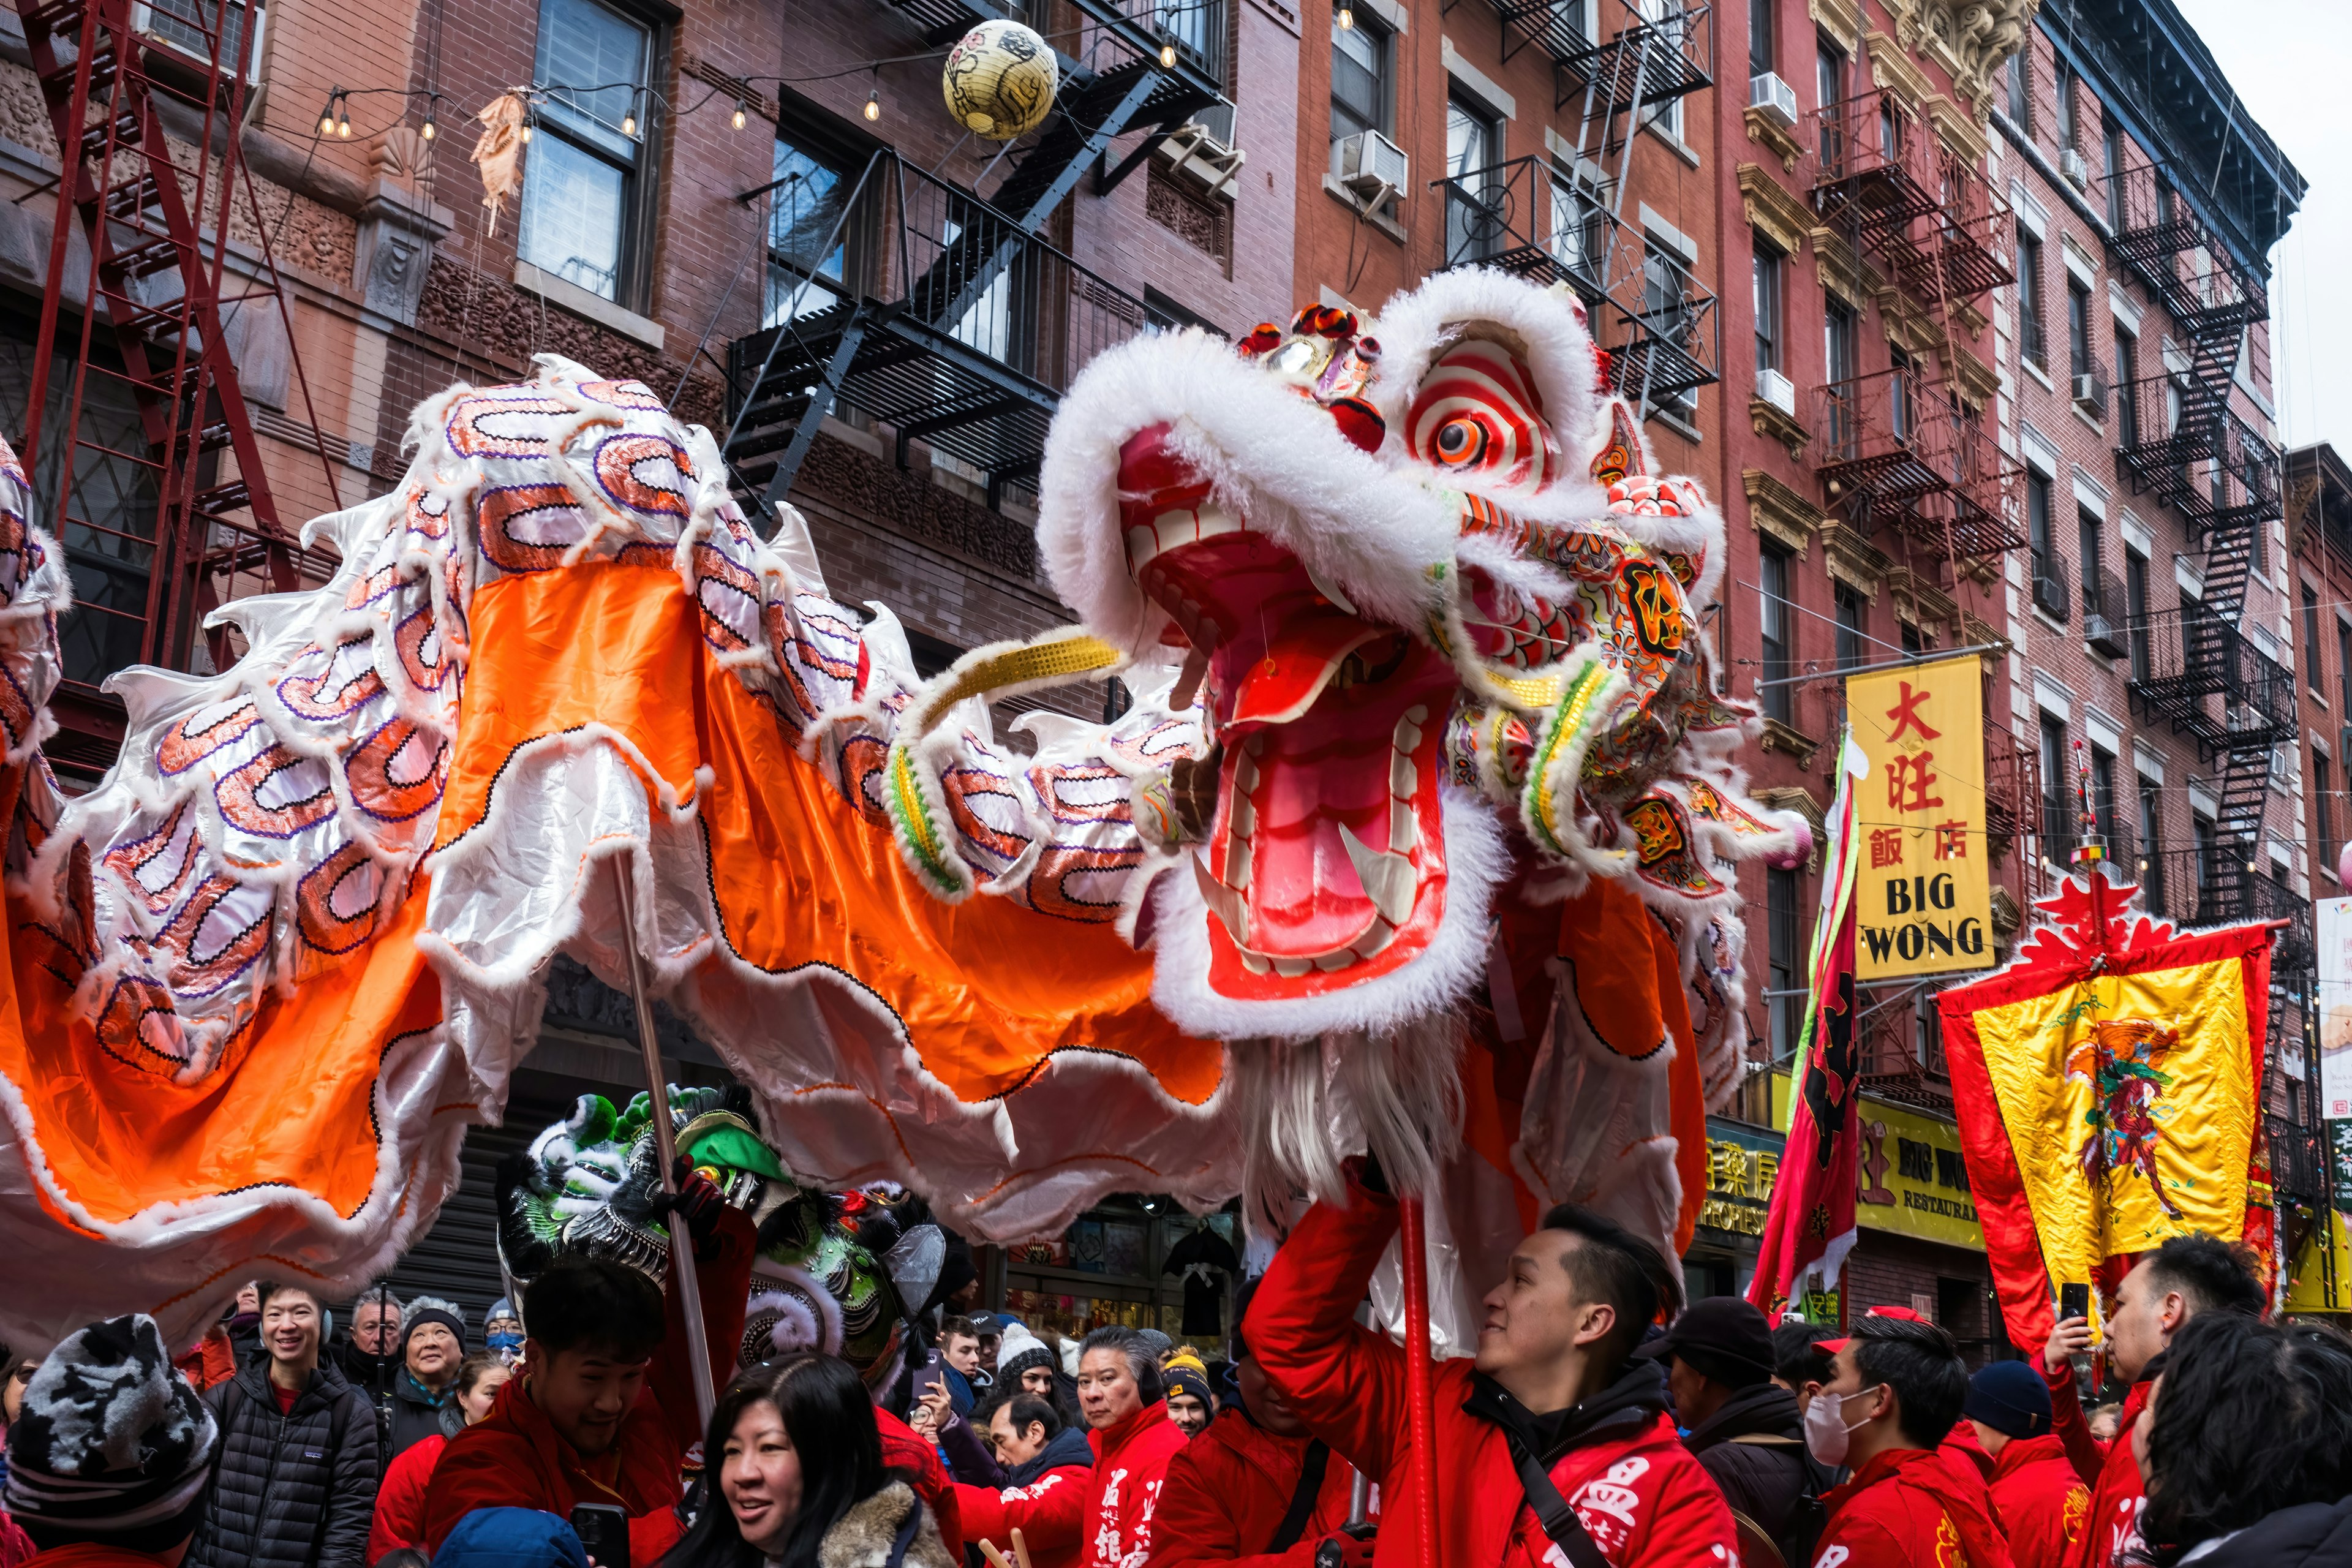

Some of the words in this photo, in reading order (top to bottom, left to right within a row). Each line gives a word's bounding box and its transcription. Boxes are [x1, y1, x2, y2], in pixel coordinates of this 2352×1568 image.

[1885, 681, 1943, 815] 大旺
[1869, 819, 1967, 869] 飯店
[1887, 873, 1955, 915] BIG
[1865, 917, 1983, 964] WONG
[1898, 1137, 1934, 1183] BIG
[1936, 1148, 1972, 1193] WO
